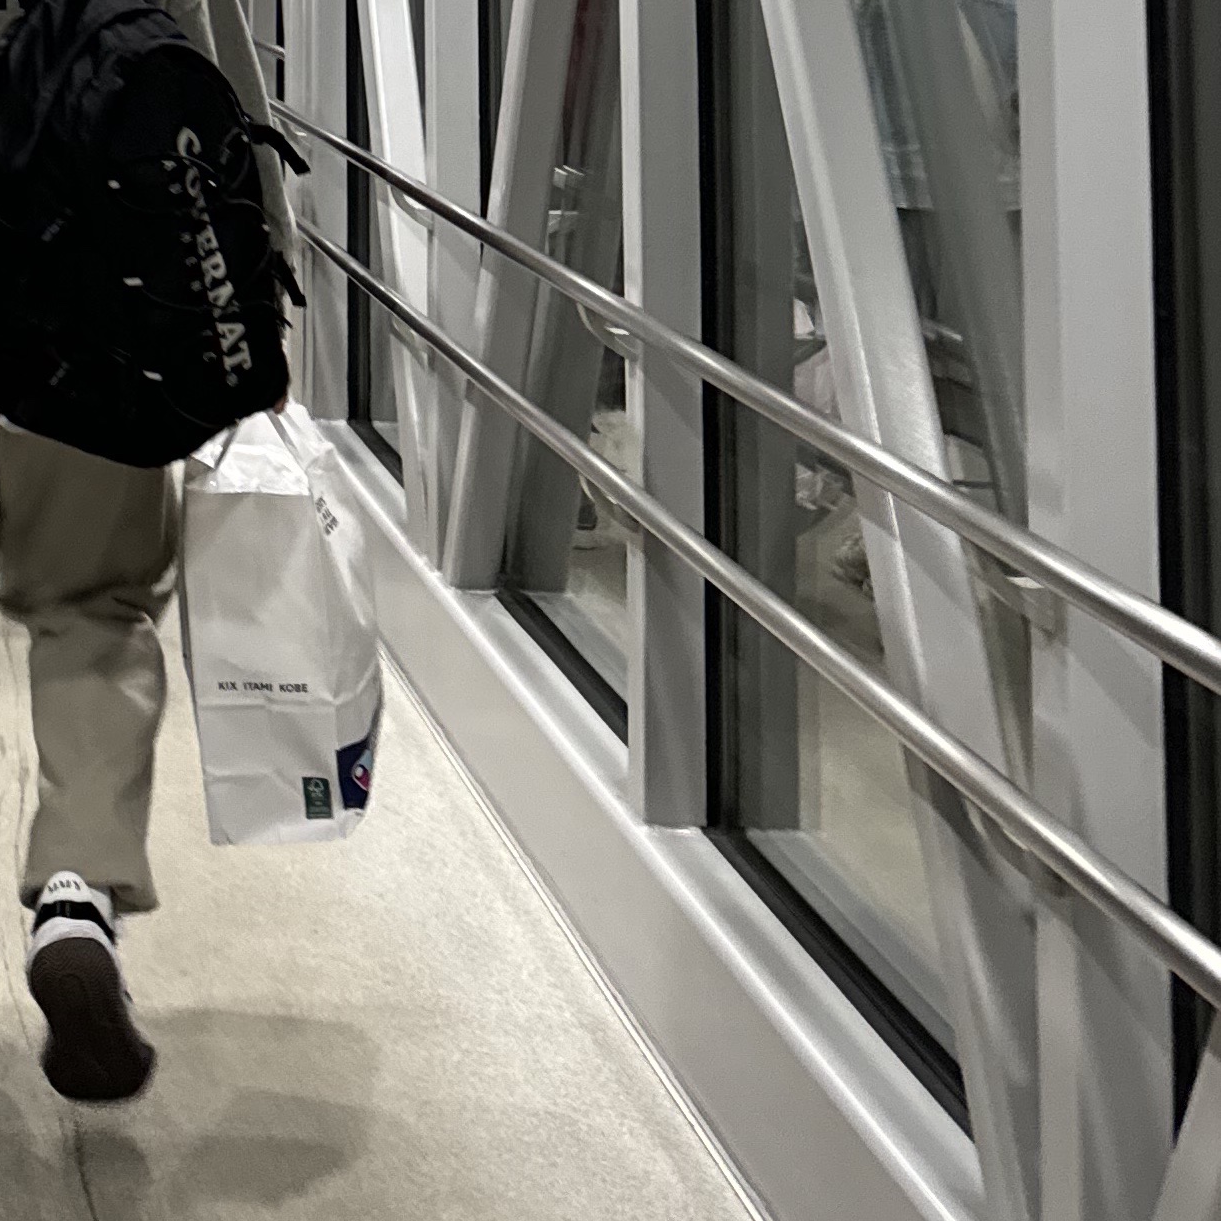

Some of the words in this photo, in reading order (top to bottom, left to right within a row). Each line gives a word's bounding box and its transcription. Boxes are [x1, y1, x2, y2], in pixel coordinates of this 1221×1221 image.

[217, 681, 237, 691] KIX
[242, 681, 273, 692] ITAMI
[278, 683, 308, 693] KOBE
